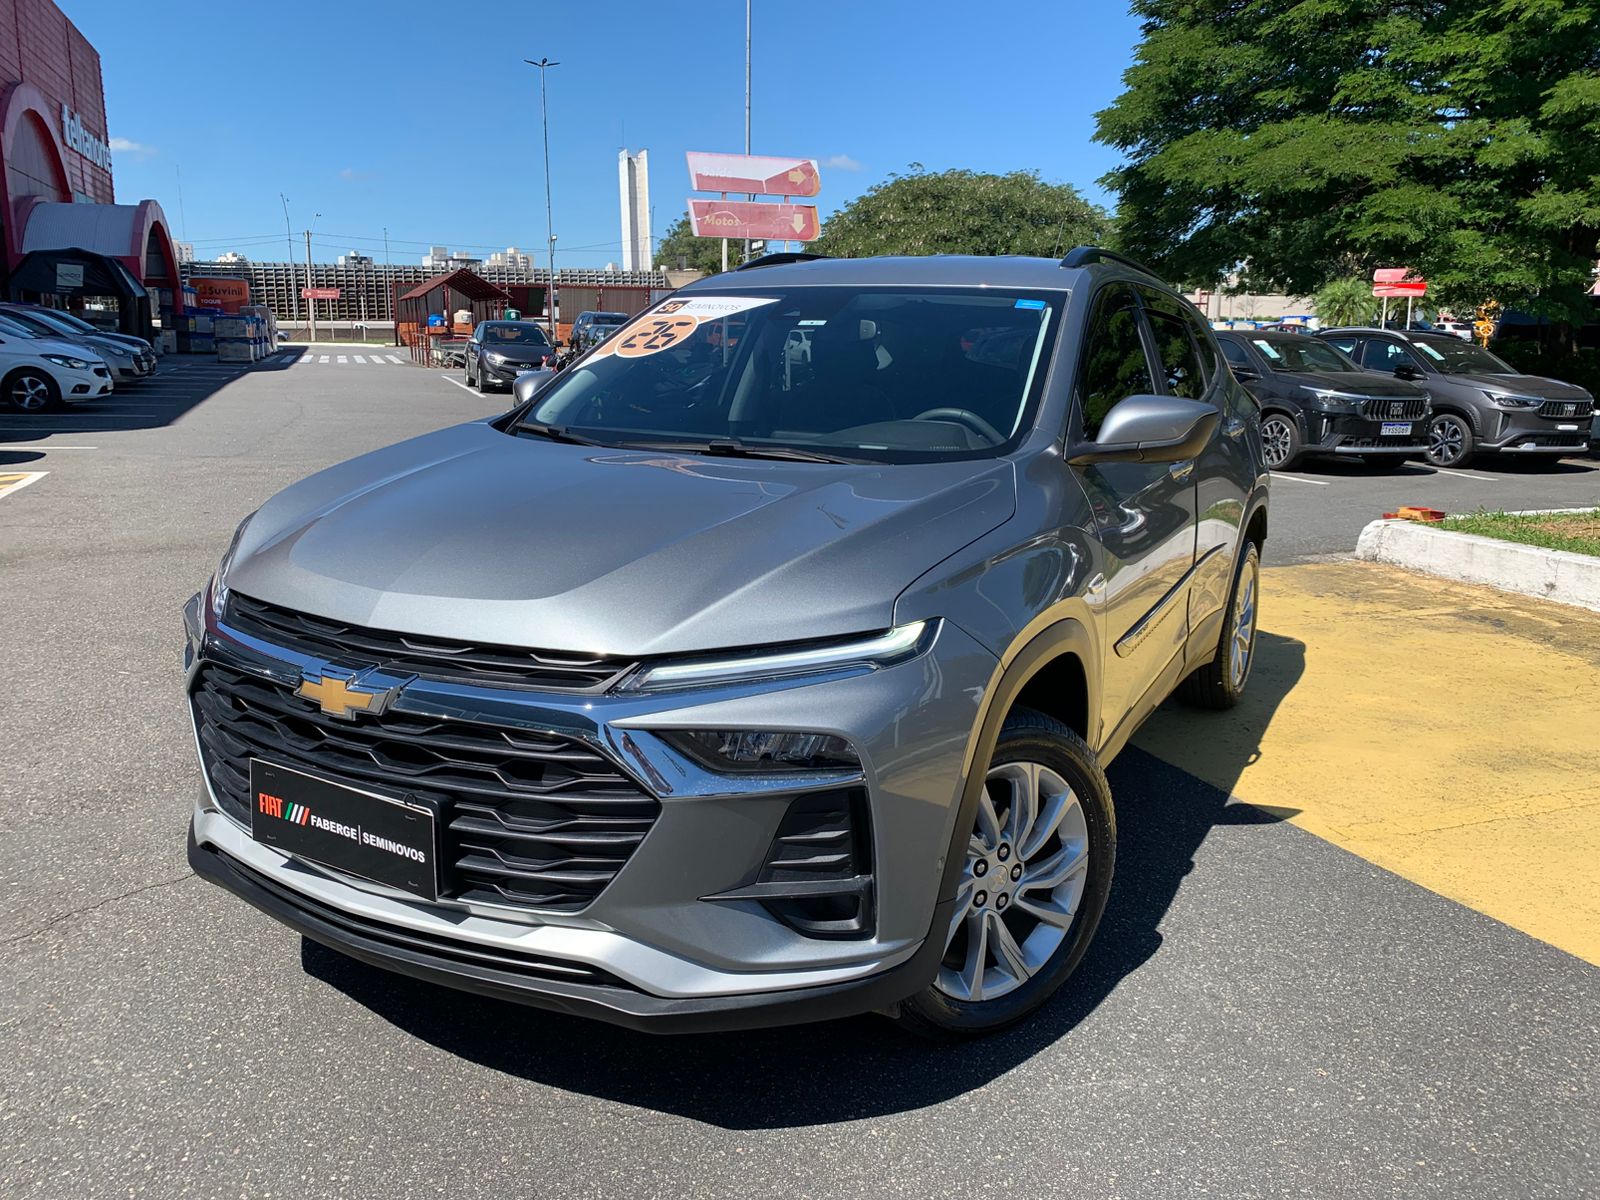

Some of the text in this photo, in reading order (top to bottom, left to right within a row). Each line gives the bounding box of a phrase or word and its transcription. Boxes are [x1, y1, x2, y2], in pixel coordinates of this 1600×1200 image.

[64, 104, 112, 175] telhanorte
[704, 214, 739, 226] Motos
[208, 286, 243, 297] Suvinil
[258, 792, 425, 863] FIAT FABERGE SEMINOVOS
